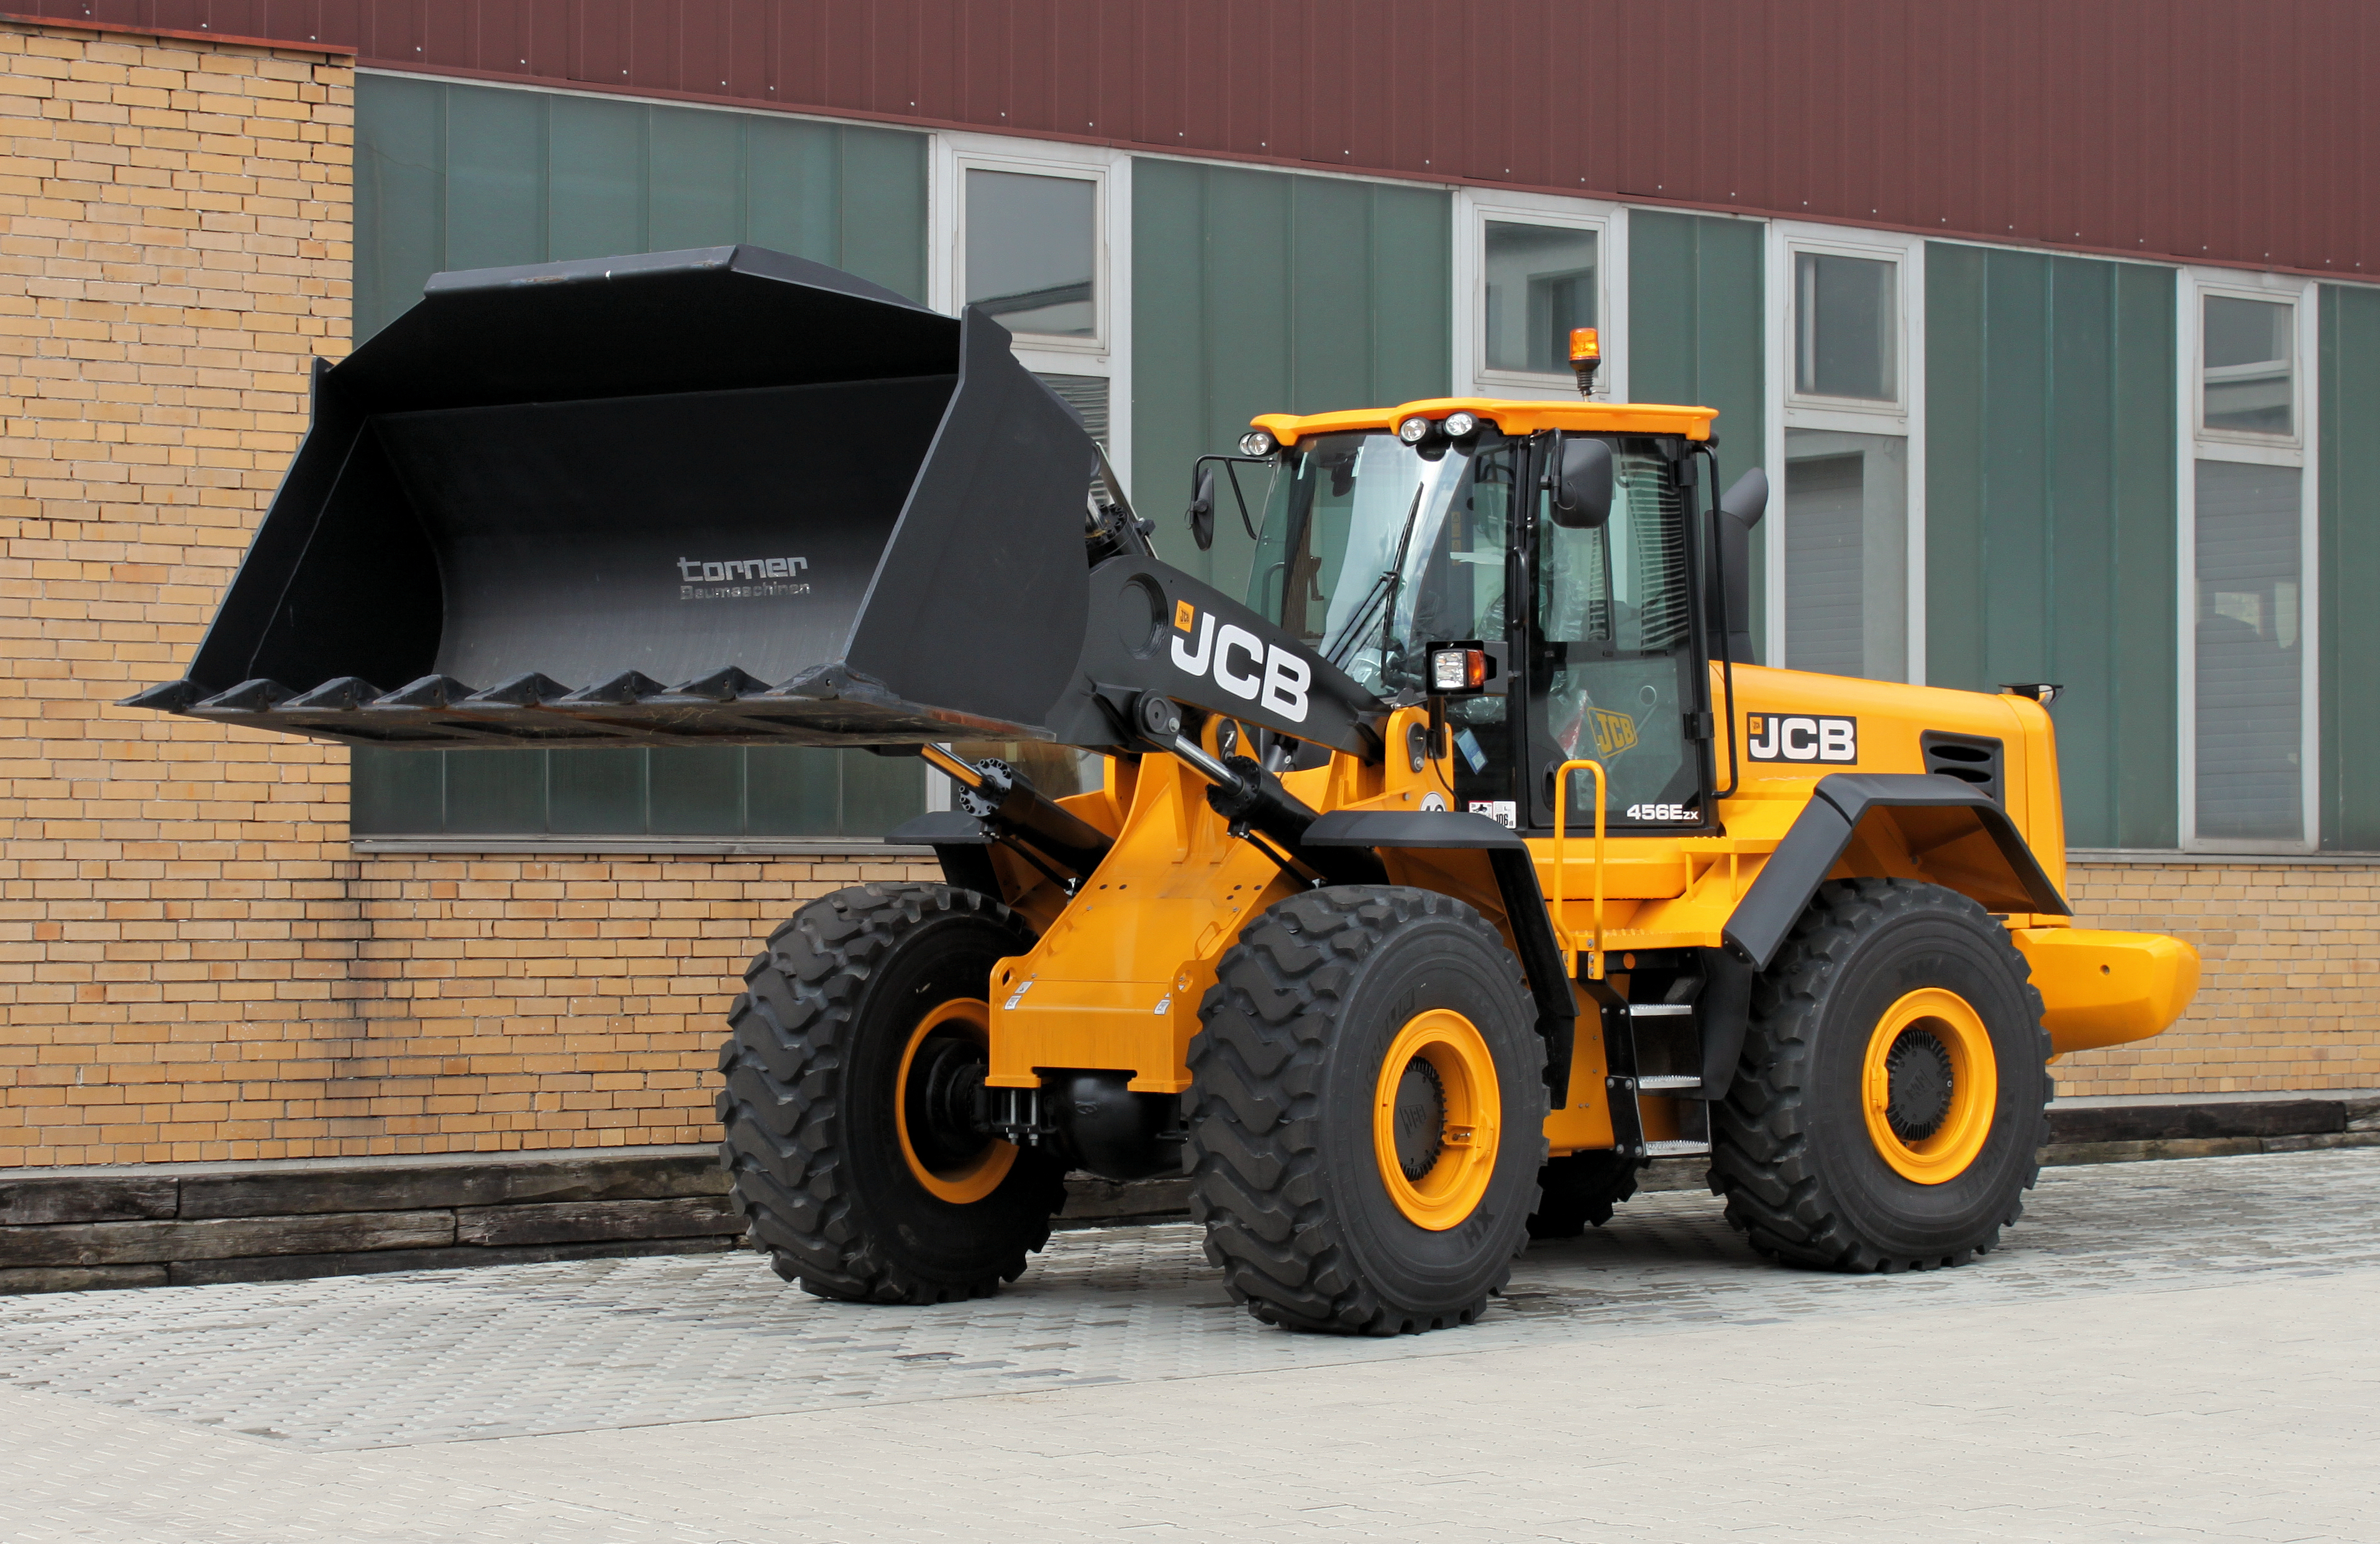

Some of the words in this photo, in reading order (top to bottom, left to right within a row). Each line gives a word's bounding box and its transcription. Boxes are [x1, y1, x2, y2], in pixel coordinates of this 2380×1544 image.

[677, 557, 808, 582] torner
[680, 582, 810, 600] Baumaschinen
[1170, 611, 1311, 723] JCB
[1595, 713, 1635, 754] JCB
[1749, 717, 1855, 761] JCB
